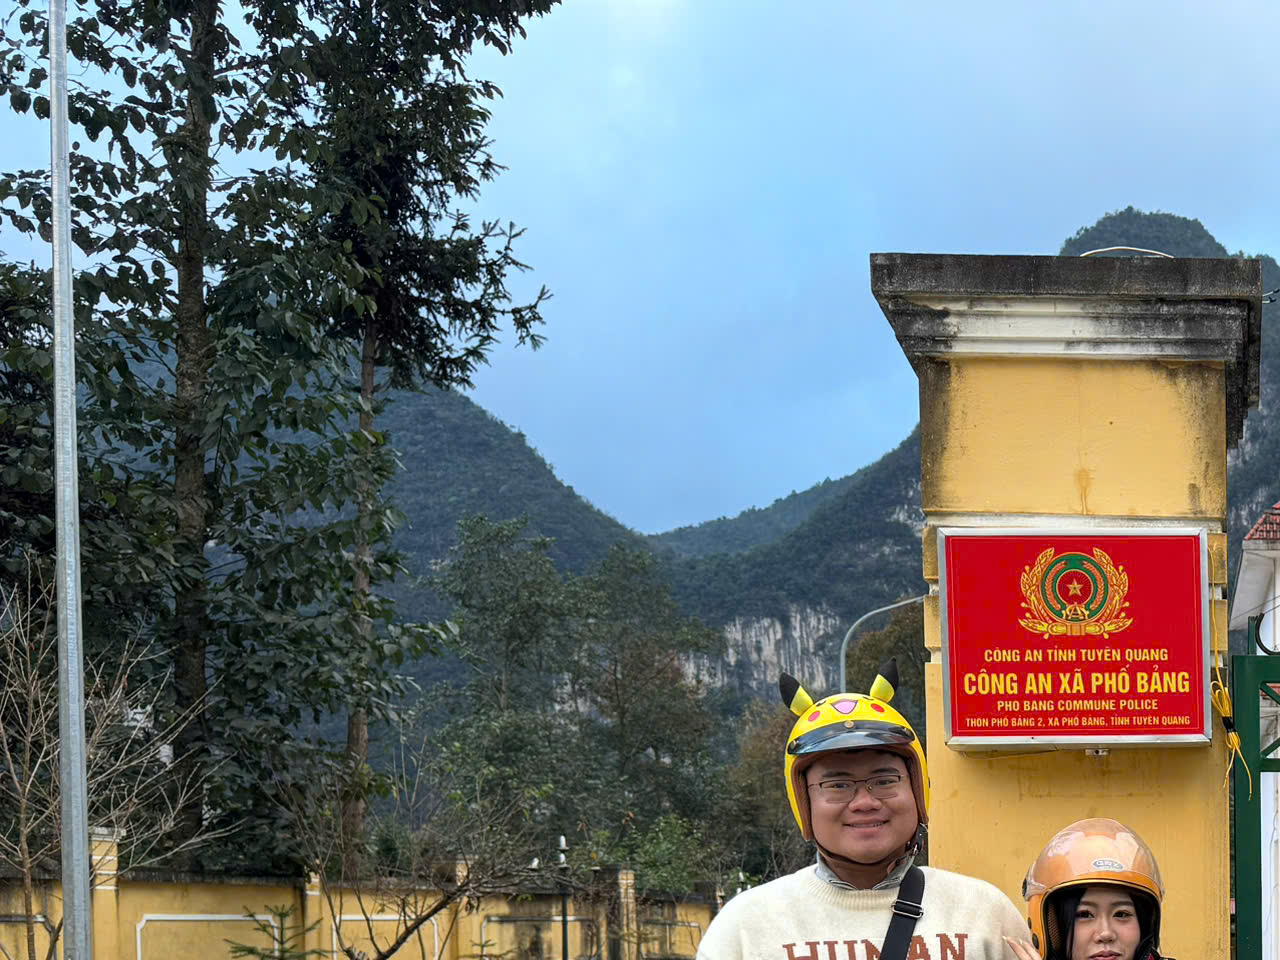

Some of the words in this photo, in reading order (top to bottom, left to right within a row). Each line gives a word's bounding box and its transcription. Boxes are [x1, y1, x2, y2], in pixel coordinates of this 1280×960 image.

[1024, 649, 1043, 662] AN
[1125, 648, 1169, 663] QUANG
[963, 668, 1018, 695] CÔNG
[1025, 672, 1053, 694] AN
[1059, 668, 1085, 694] XÃ
[1091, 664, 1130, 694] PHỐ
[1136, 664, 1190, 693] BẢNG
[997, 700, 1020, 712] PHO
[1024, 700, 1055, 712] BANG
[1058, 700, 1117, 711] COMMUNE
[1119, 699, 1159, 710] POLICE
[1161, 715, 1191, 726] QUANG
